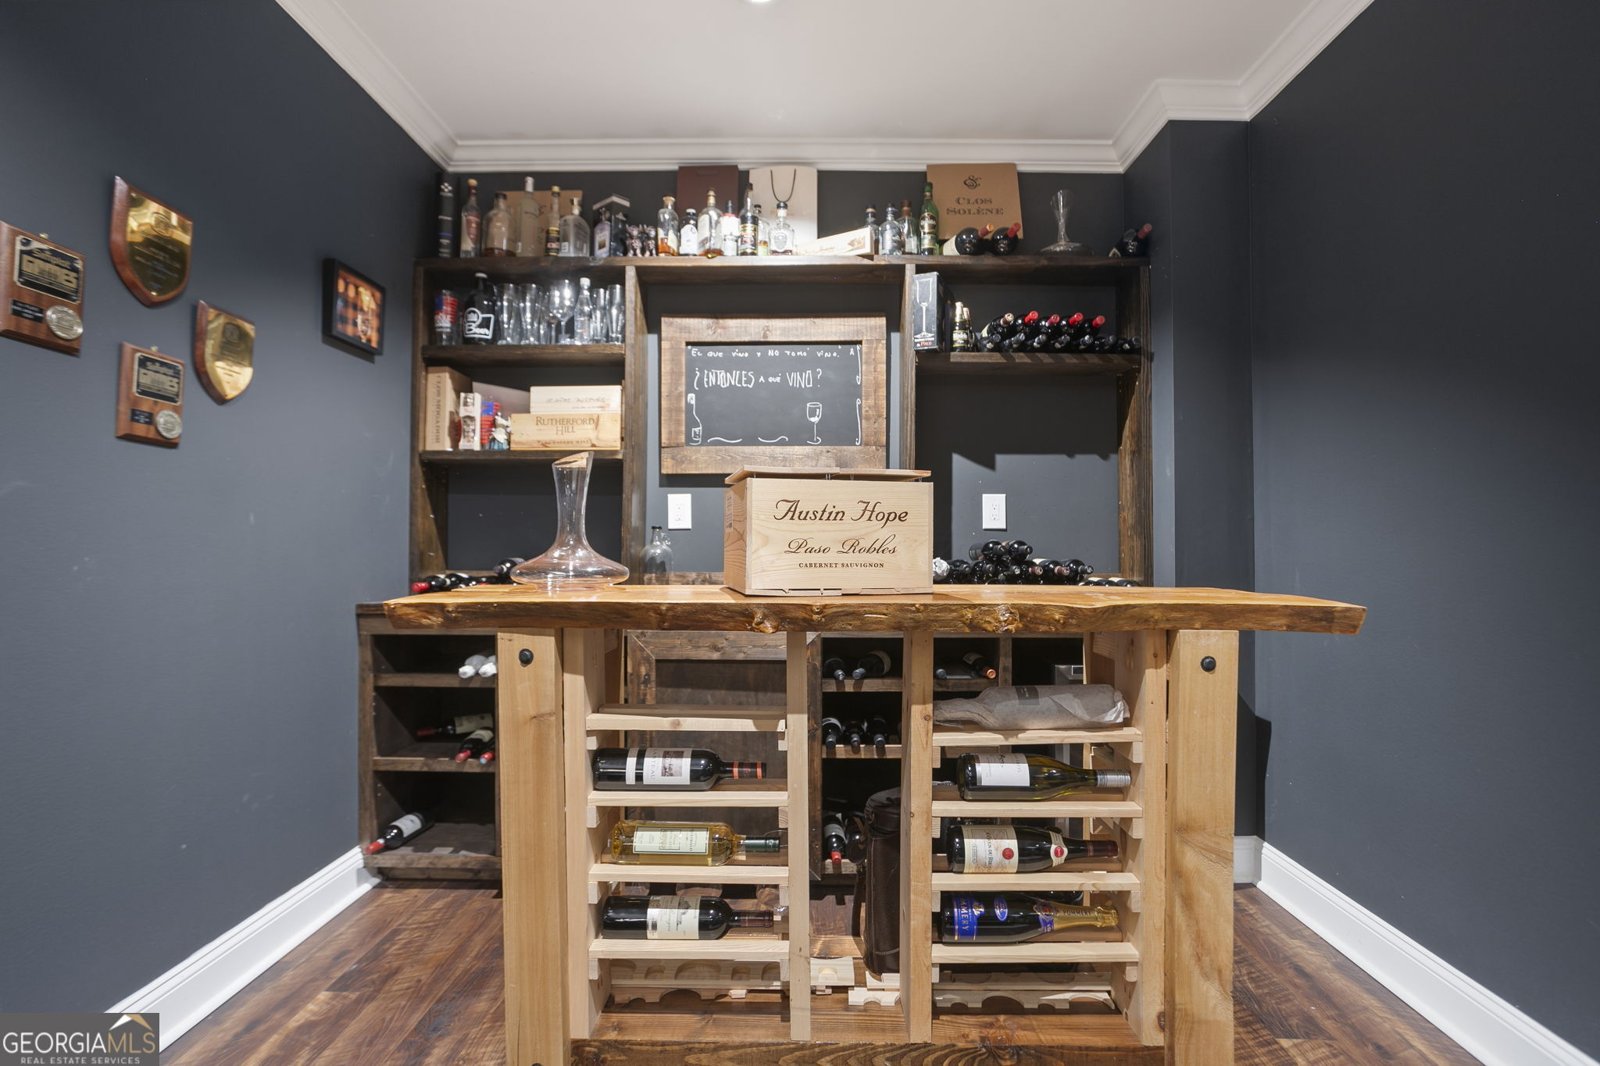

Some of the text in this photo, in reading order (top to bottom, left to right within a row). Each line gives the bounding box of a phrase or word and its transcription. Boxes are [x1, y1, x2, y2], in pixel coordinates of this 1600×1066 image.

[955, 196, 993, 206] CLOS
[768, 349, 780, 357] NO
[535, 416, 595, 427] RUTHERFORD
[555, 426, 576, 436] HILL
[773, 499, 909, 529] Austin Hope
[784, 533, 897, 555] Paso Robles
